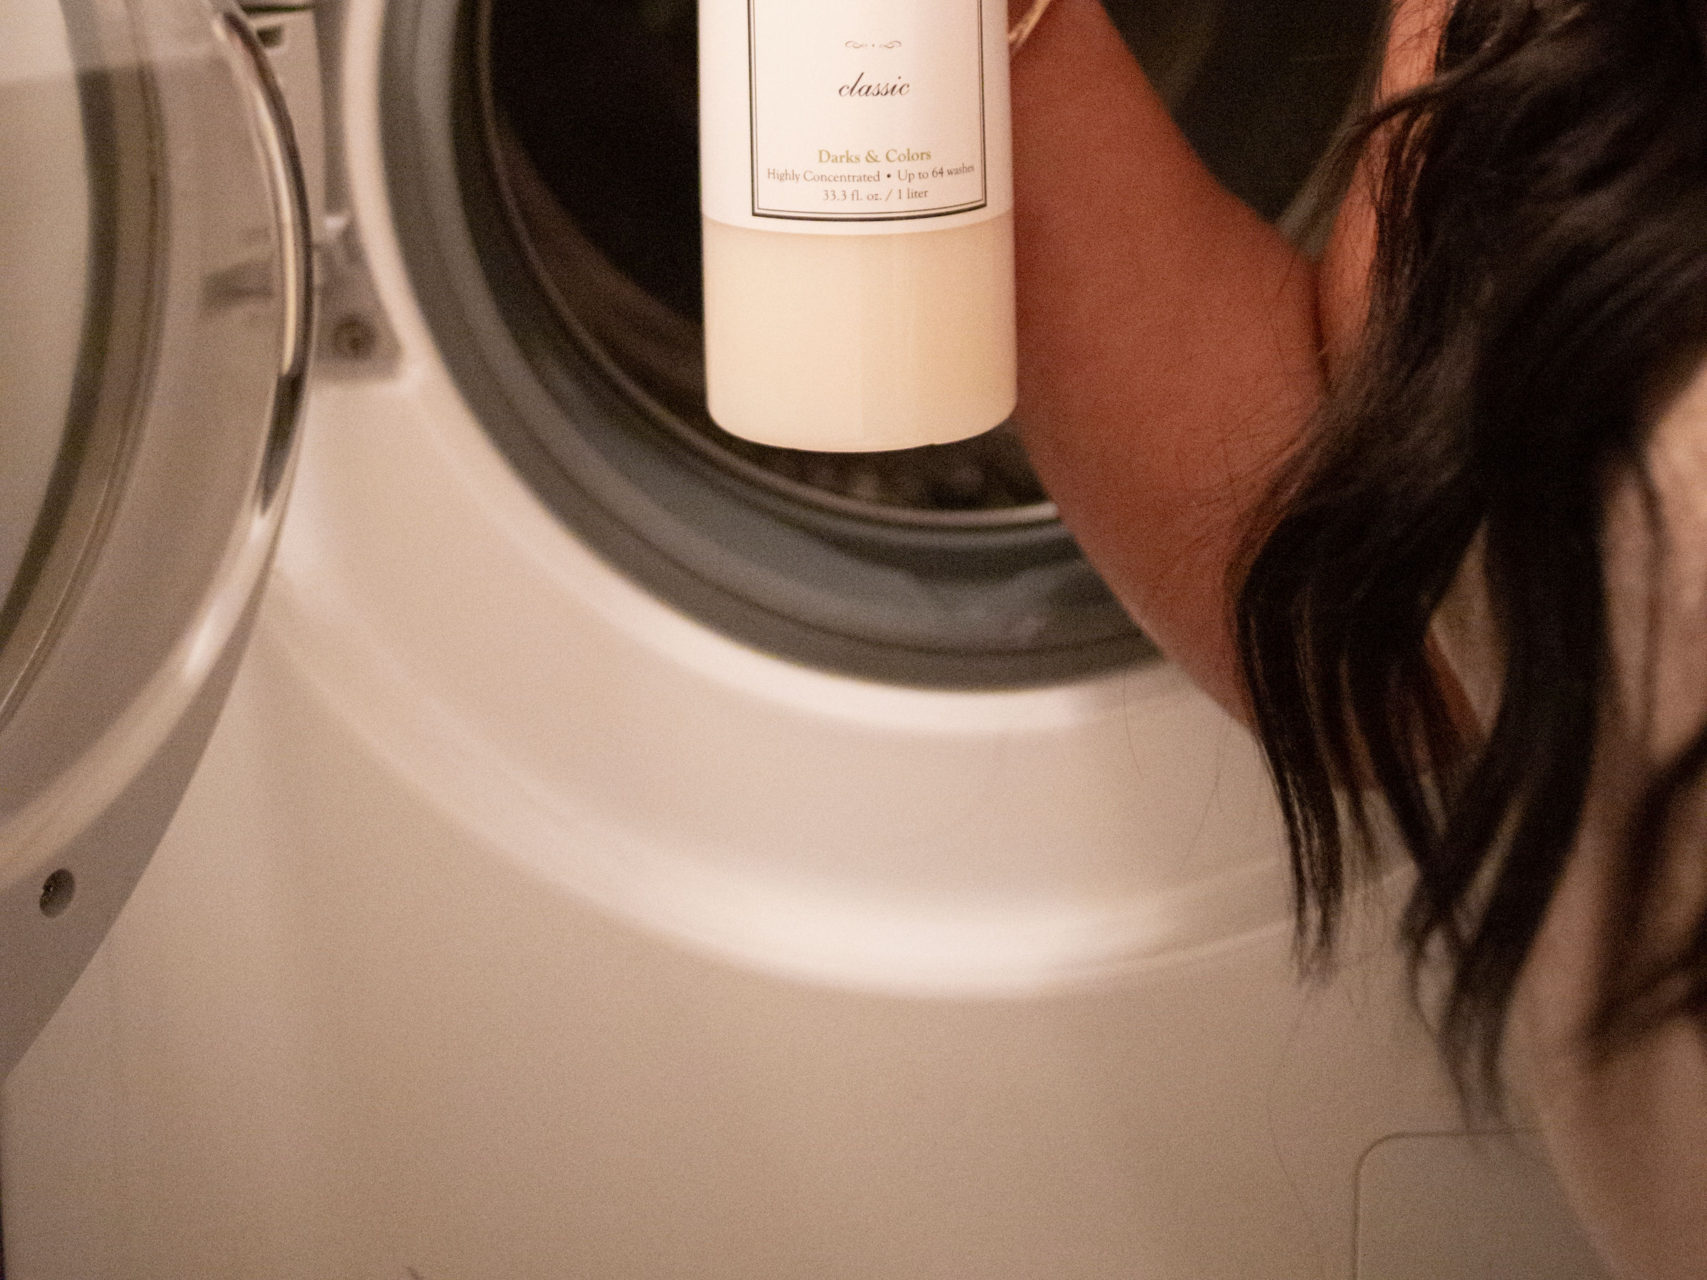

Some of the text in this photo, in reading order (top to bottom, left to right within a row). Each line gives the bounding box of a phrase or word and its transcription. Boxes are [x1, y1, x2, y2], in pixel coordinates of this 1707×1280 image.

[838, 72, 911, 97] classic
[818, 147, 932, 163] Darks & Colors
[767, 168, 800, 183] Highly
[803, 169, 880, 183] Concentrated
[897, 169, 915, 184] Up
[918, 169, 929, 180] to
[931, 167, 944, 178] 64
[823, 189, 848, 200] 33.3
[851, 188, 863, 200] fl.
[866, 191, 882, 200] oz.
[906, 187, 929, 199] liter
